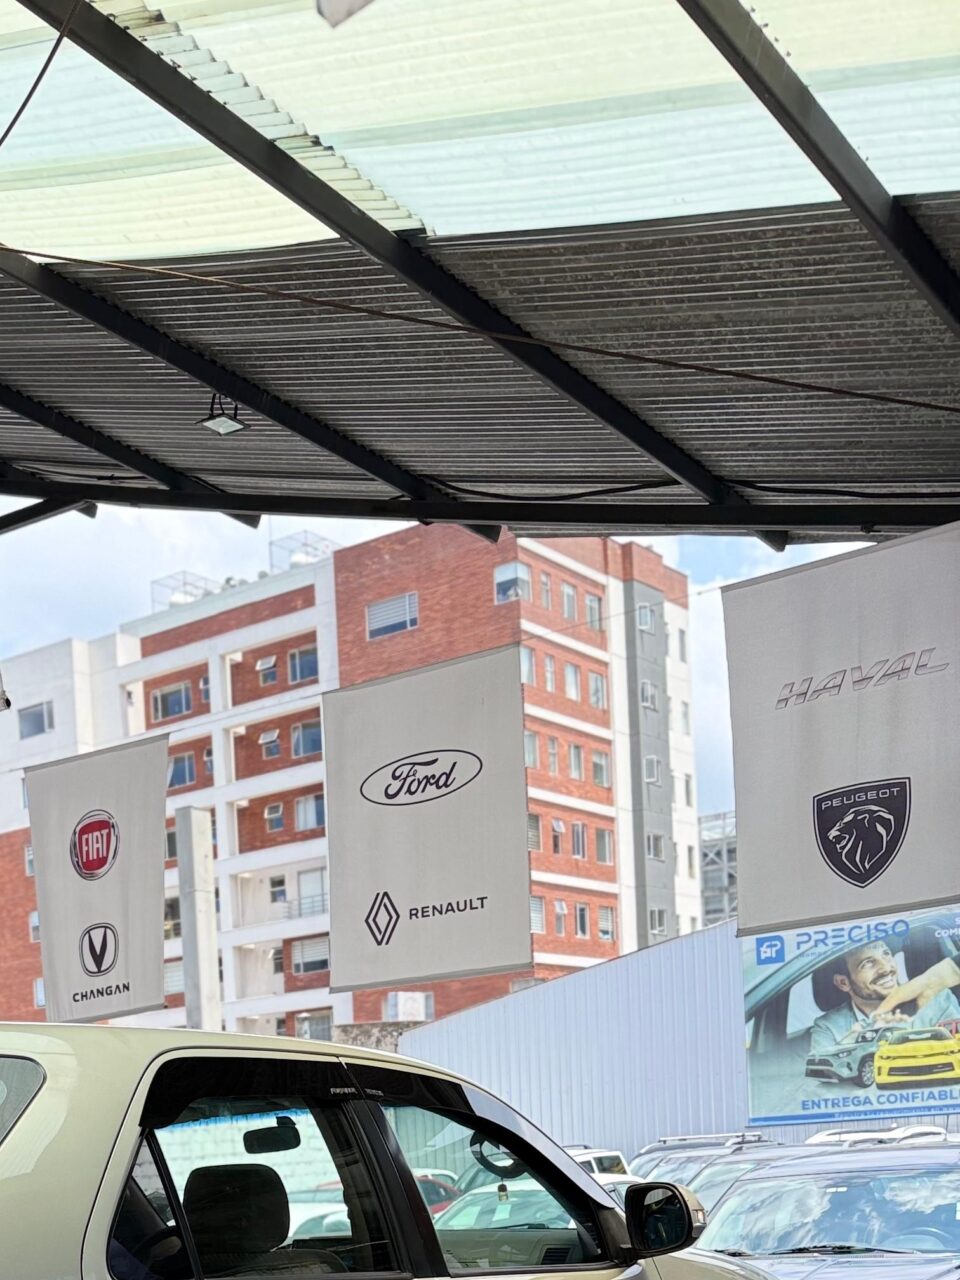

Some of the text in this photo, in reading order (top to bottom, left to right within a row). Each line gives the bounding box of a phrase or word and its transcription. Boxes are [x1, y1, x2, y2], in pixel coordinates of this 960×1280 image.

[775, 647, 949, 710] HAVAL
[383, 757, 458, 800] Ford
[821, 787, 900, 810] PEUGEOT
[81, 827, 111, 863] FIAT
[409, 896, 488, 921] RENAULT
[796, 919, 910, 950] PRECISO
[72, 981, 131, 1003] CHANGAN
[801, 1089, 960, 1111] ENTREGA CONFIABL
